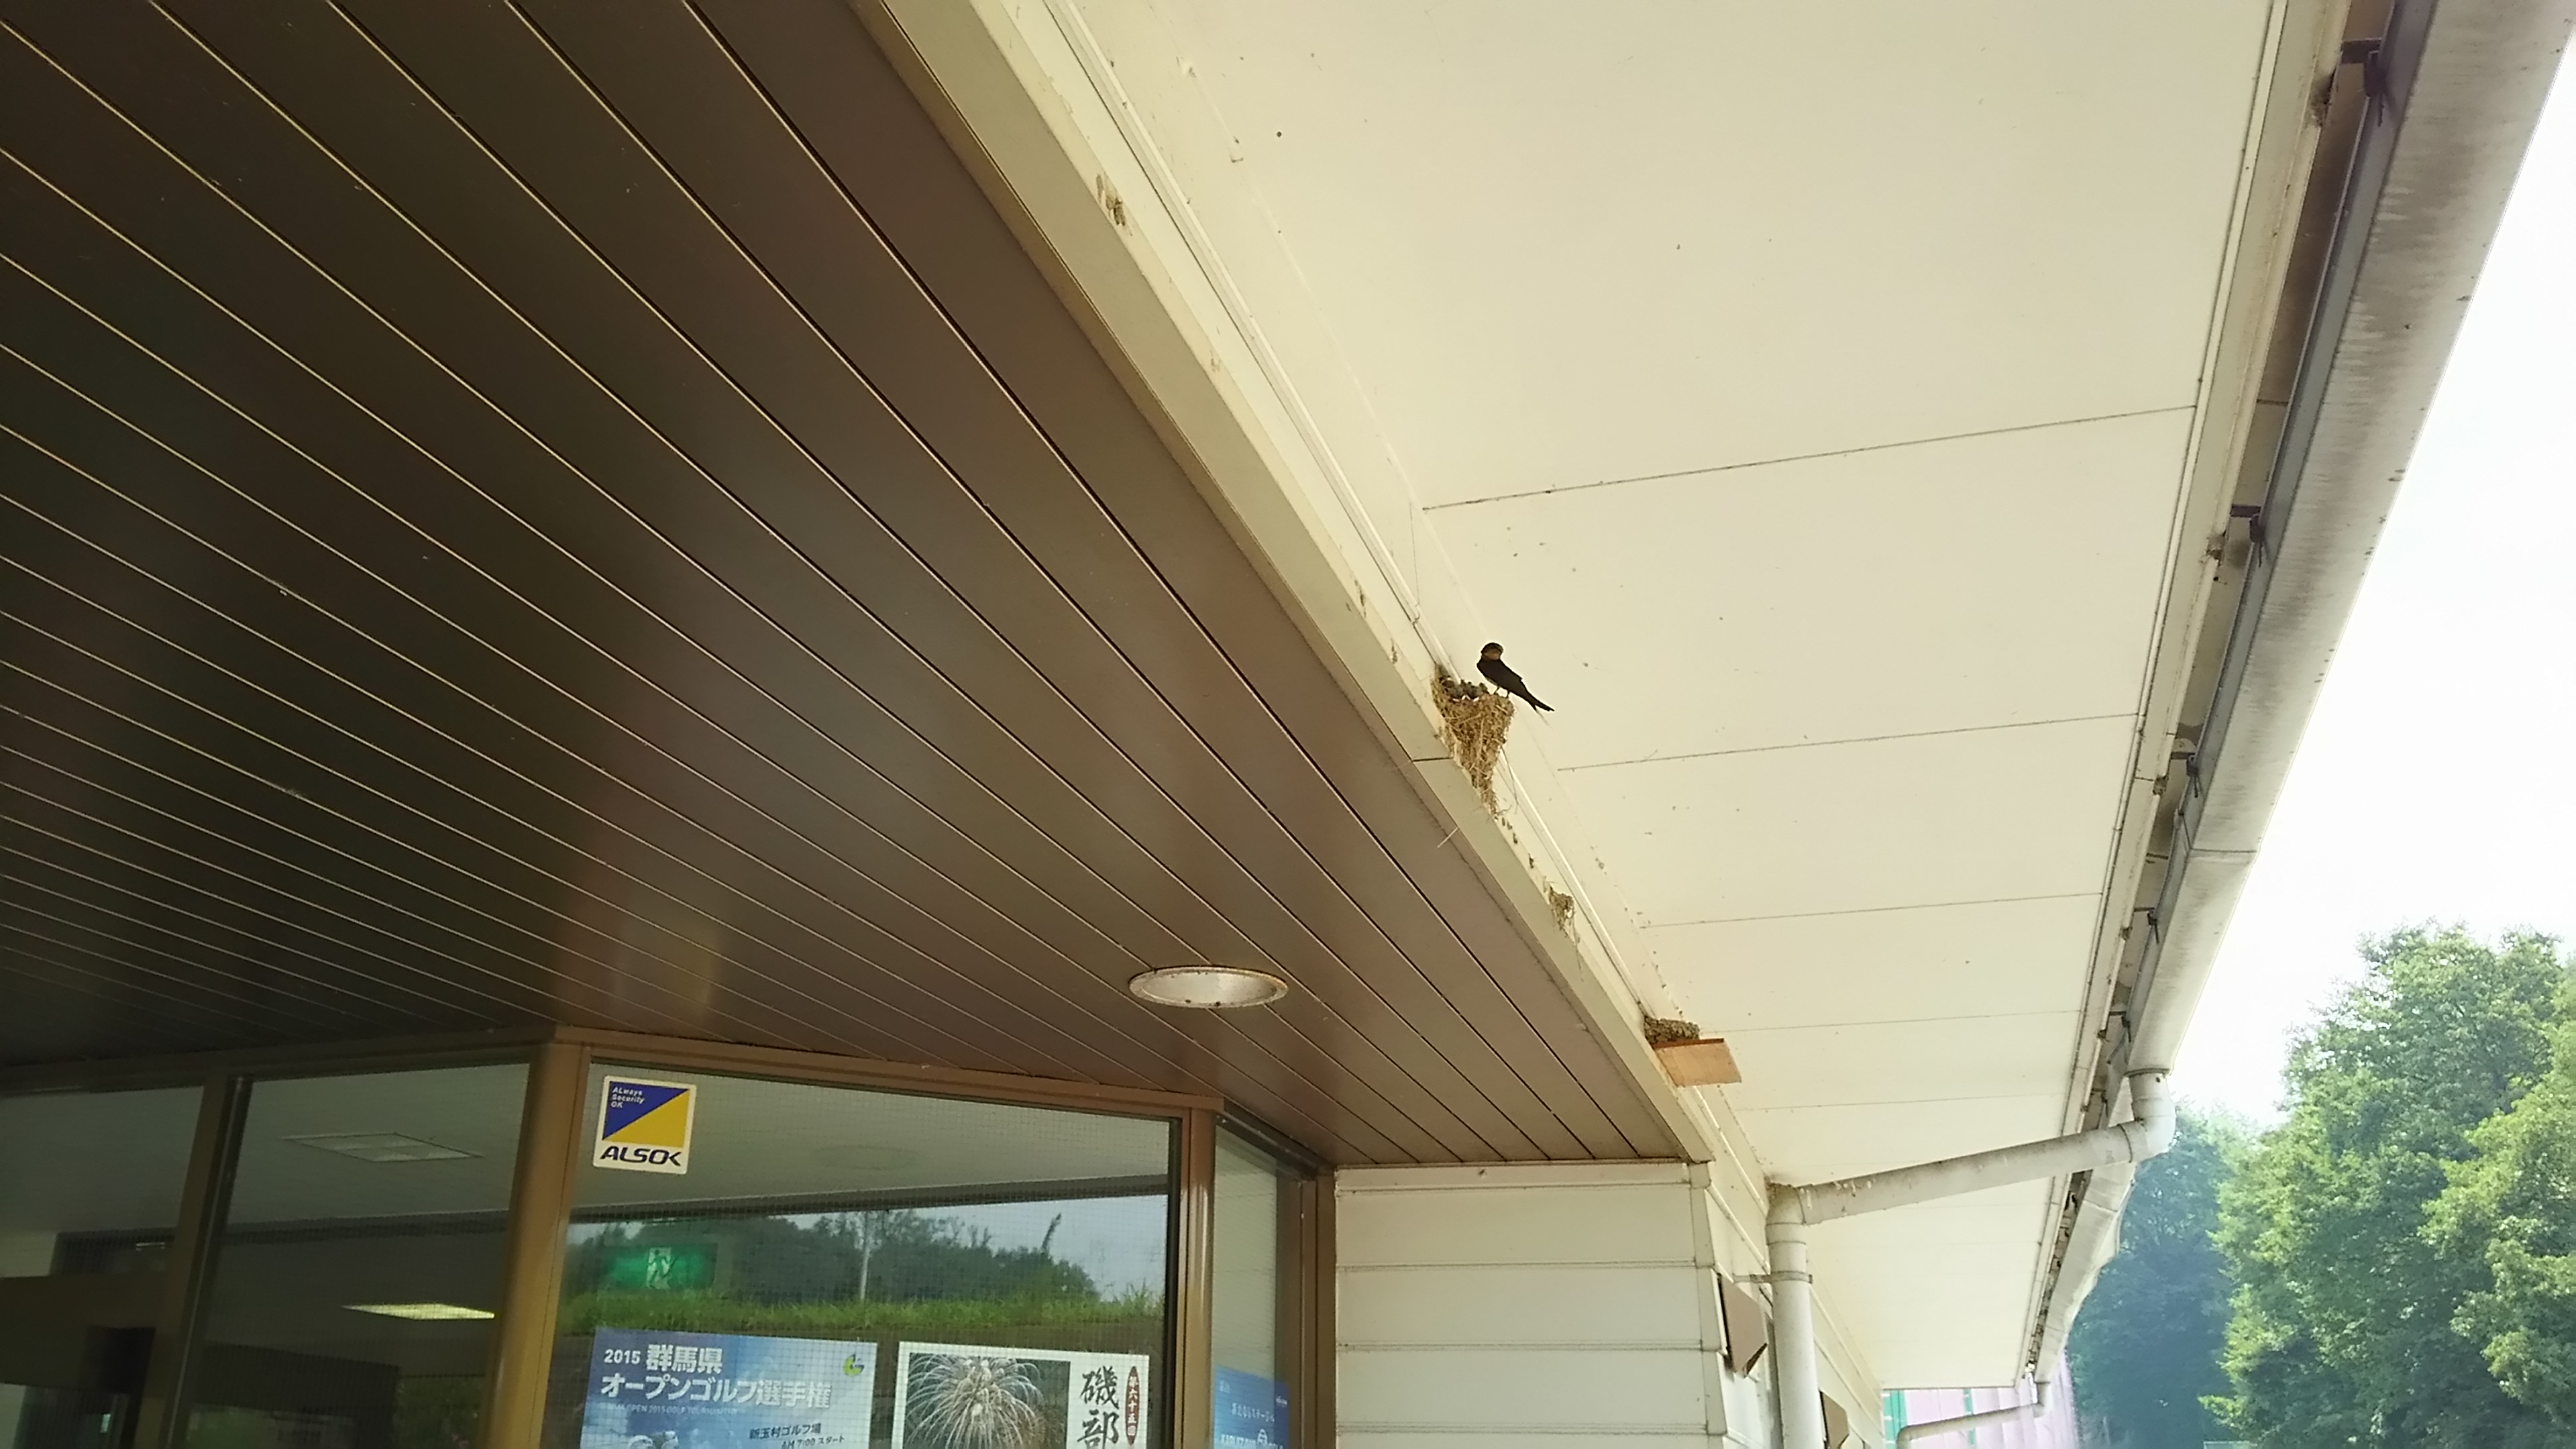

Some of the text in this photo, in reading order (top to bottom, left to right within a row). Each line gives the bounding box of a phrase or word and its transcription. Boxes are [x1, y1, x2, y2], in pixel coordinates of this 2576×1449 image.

[611, 1094, 645, 1104] Security
[600, 1146, 682, 1166] ALSOK
[604, 1344, 723, 1374] 2015 群馬県
[601, 1373, 832, 1409] オープンゴルフ選手権
